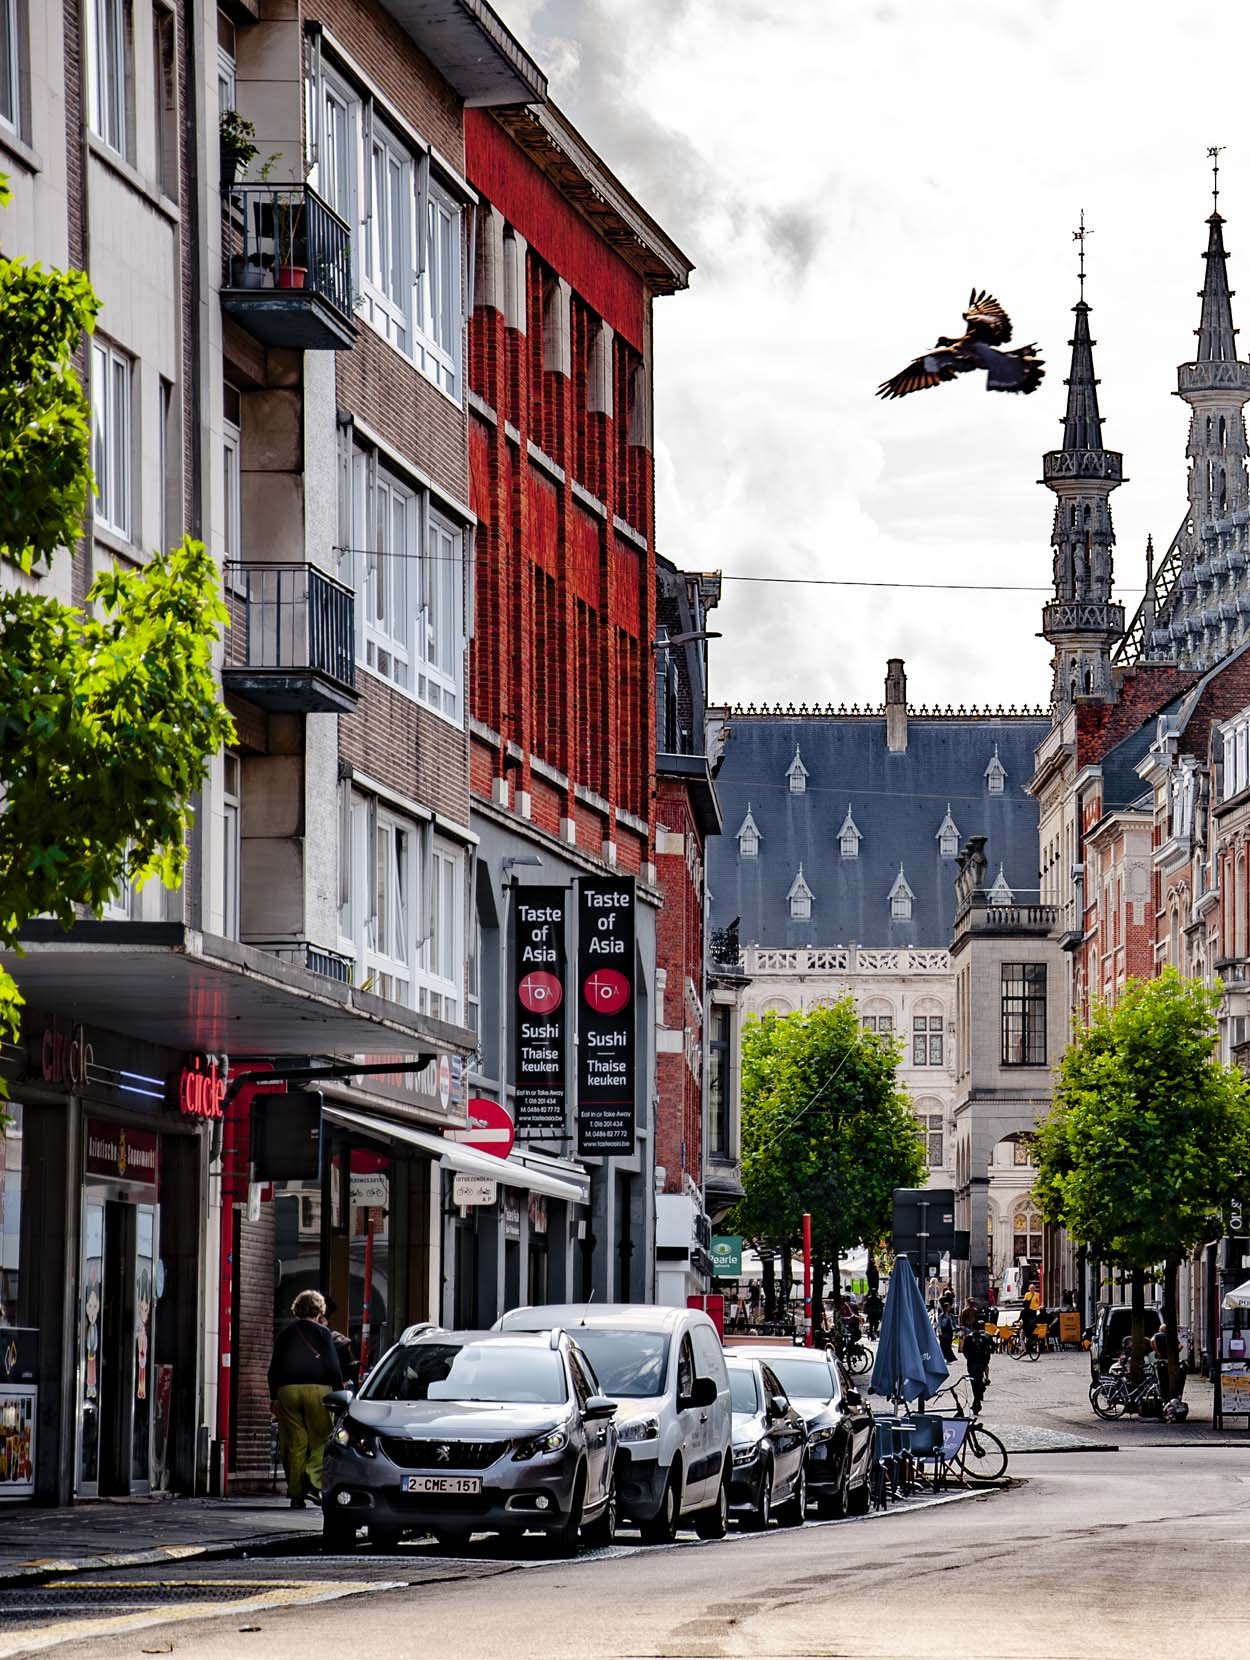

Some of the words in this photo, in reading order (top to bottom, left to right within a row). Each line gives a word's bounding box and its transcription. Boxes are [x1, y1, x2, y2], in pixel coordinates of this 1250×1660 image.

[583, 890, 630, 907] Taste
[518, 906, 562, 922] Taste
[597, 913, 616, 930] of
[531, 925, 549, 942] of
[588, 936, 625, 953] Asia
[522, 946, 556, 962] Asia
[521, 1023, 559, 1038] Sushi
[587, 1031, 627, 1046] Sushi
[521, 1047, 559, 1059] Thaise
[522, 1061, 559, 1072] keuken
[587, 1060, 626, 1072] Thaise
[186, 1056, 225, 1117] circle
[587, 1074, 627, 1086] keuken
